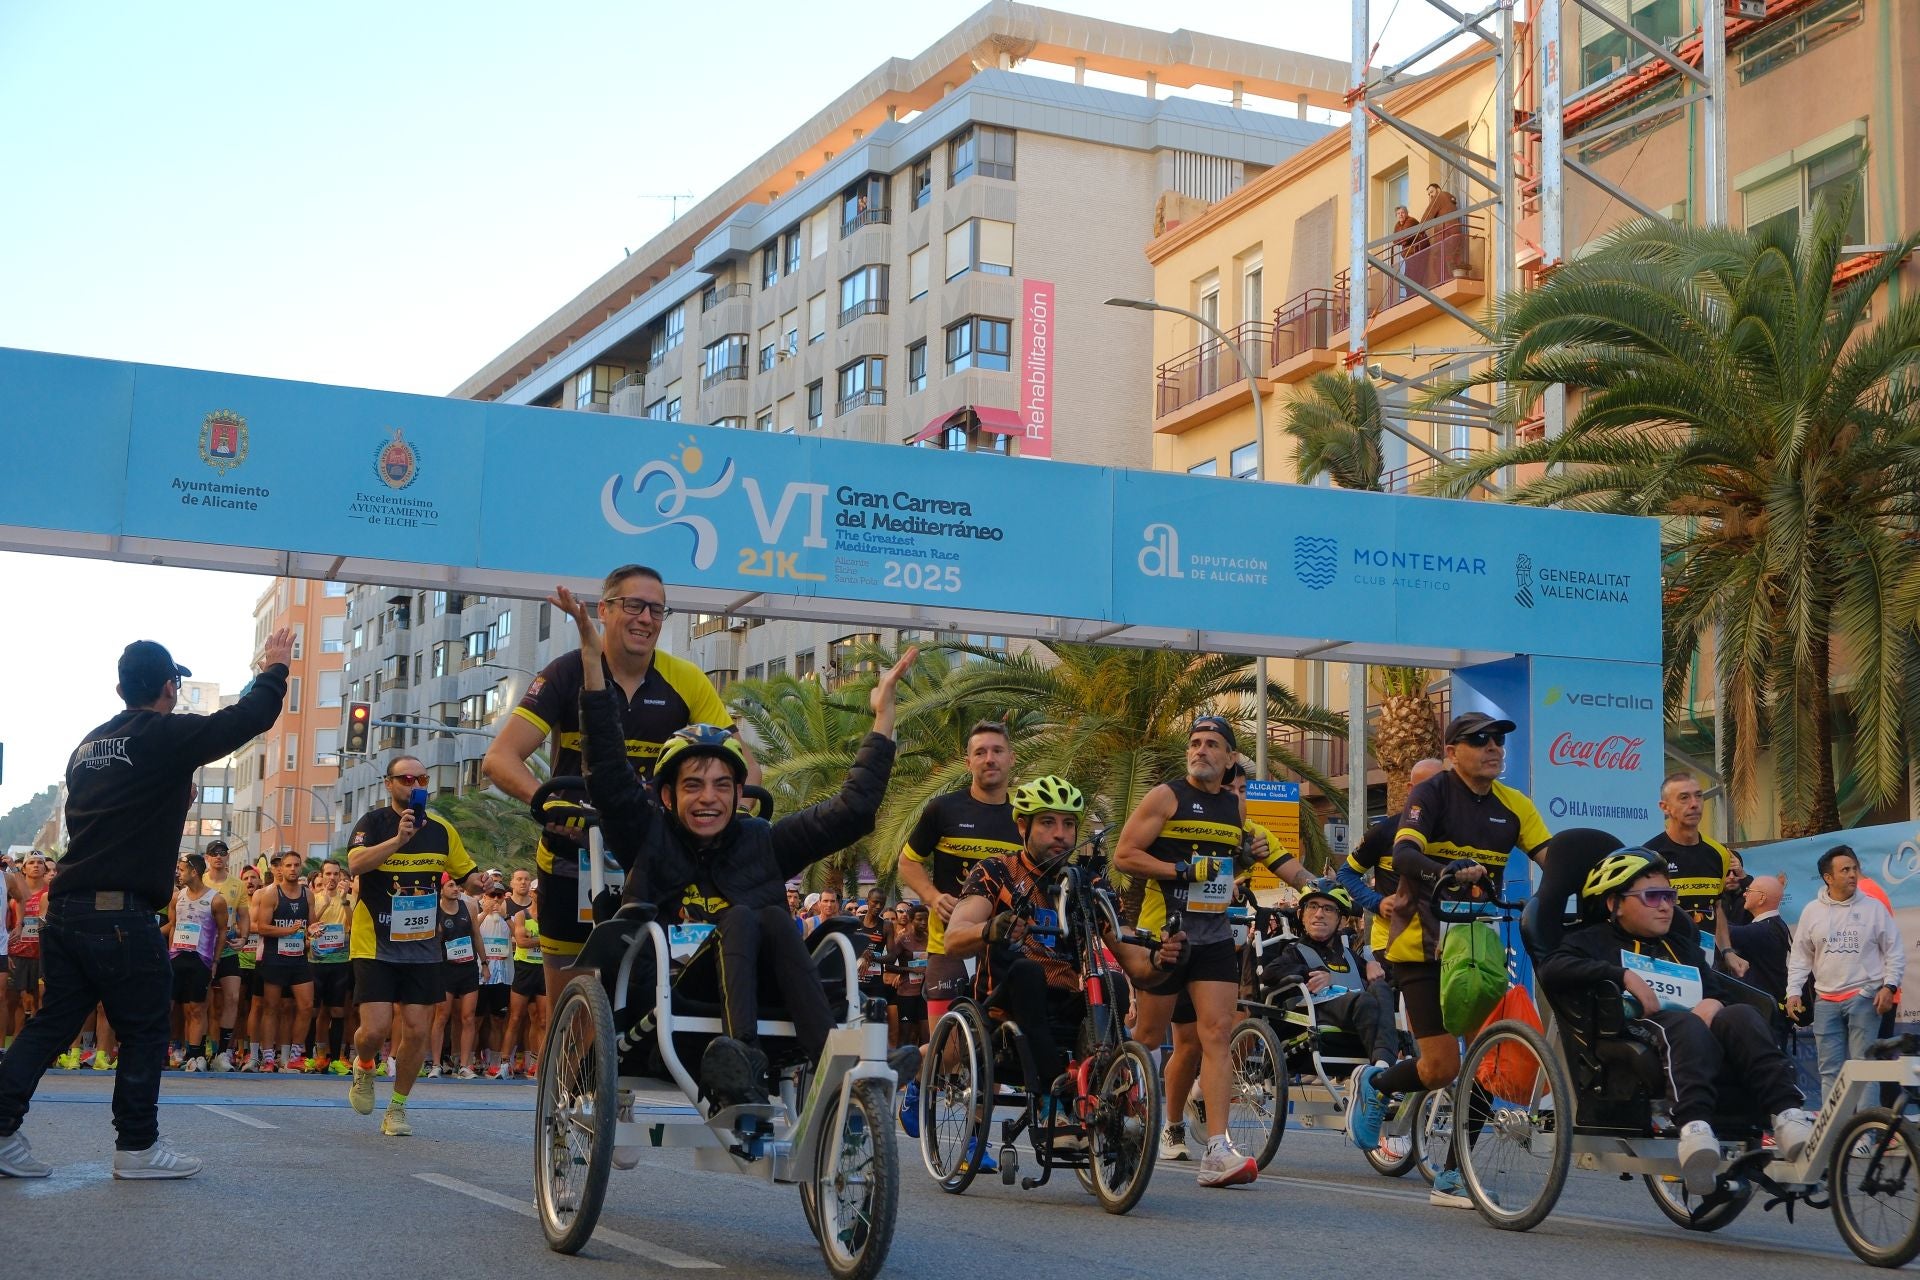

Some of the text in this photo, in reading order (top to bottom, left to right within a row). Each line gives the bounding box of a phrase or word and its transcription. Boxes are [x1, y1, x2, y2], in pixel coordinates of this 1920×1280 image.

[1026, 292, 1048, 440] Rehabilitación
[171, 477, 270, 498] Ayuntamiento
[181, 493, 258, 511] de Alicante
[836, 485, 972, 517] Gran Carrera
[349, 503, 439, 519] AYUNTAMIENTO
[742, 477, 830, 549] VI
[368, 515, 419, 528] de ELCHE
[835, 509, 1004, 542] del Mediterráneo
[835, 529, 916, 546] The Greatest
[835, 540, 960, 561] Mediterranean Race
[835, 556, 870, 567] Alicante
[835, 565, 858, 575] Elche
[1191, 554, 1268, 571] DIPUTACIÓN
[1354, 548, 1487, 575] MONTEMAR
[834, 575, 859, 584] Santa
[883, 560, 962, 593] 2025
[1191, 569, 1269, 585] DE ALICANTE
[1354, 575, 1451, 591] CLUB ATLÉTICO
[1539, 568, 1631, 588] GENERALITAT
[1540, 584, 1630, 604] VALENCIANA
[1566, 692, 1653, 710] vectalia
[1549, 731, 1646, 771] Coca-Cola
[1249, 783, 1286, 792] ALICANTE
[1569, 801, 1649, 821] HLA VISTAHERMOSA
[1171, 826, 1213, 835] ZANCADAS
[1202, 883, 1228, 895] 2396
[404, 915, 430, 927] 2385
[1645, 979, 1682, 998] 2391
